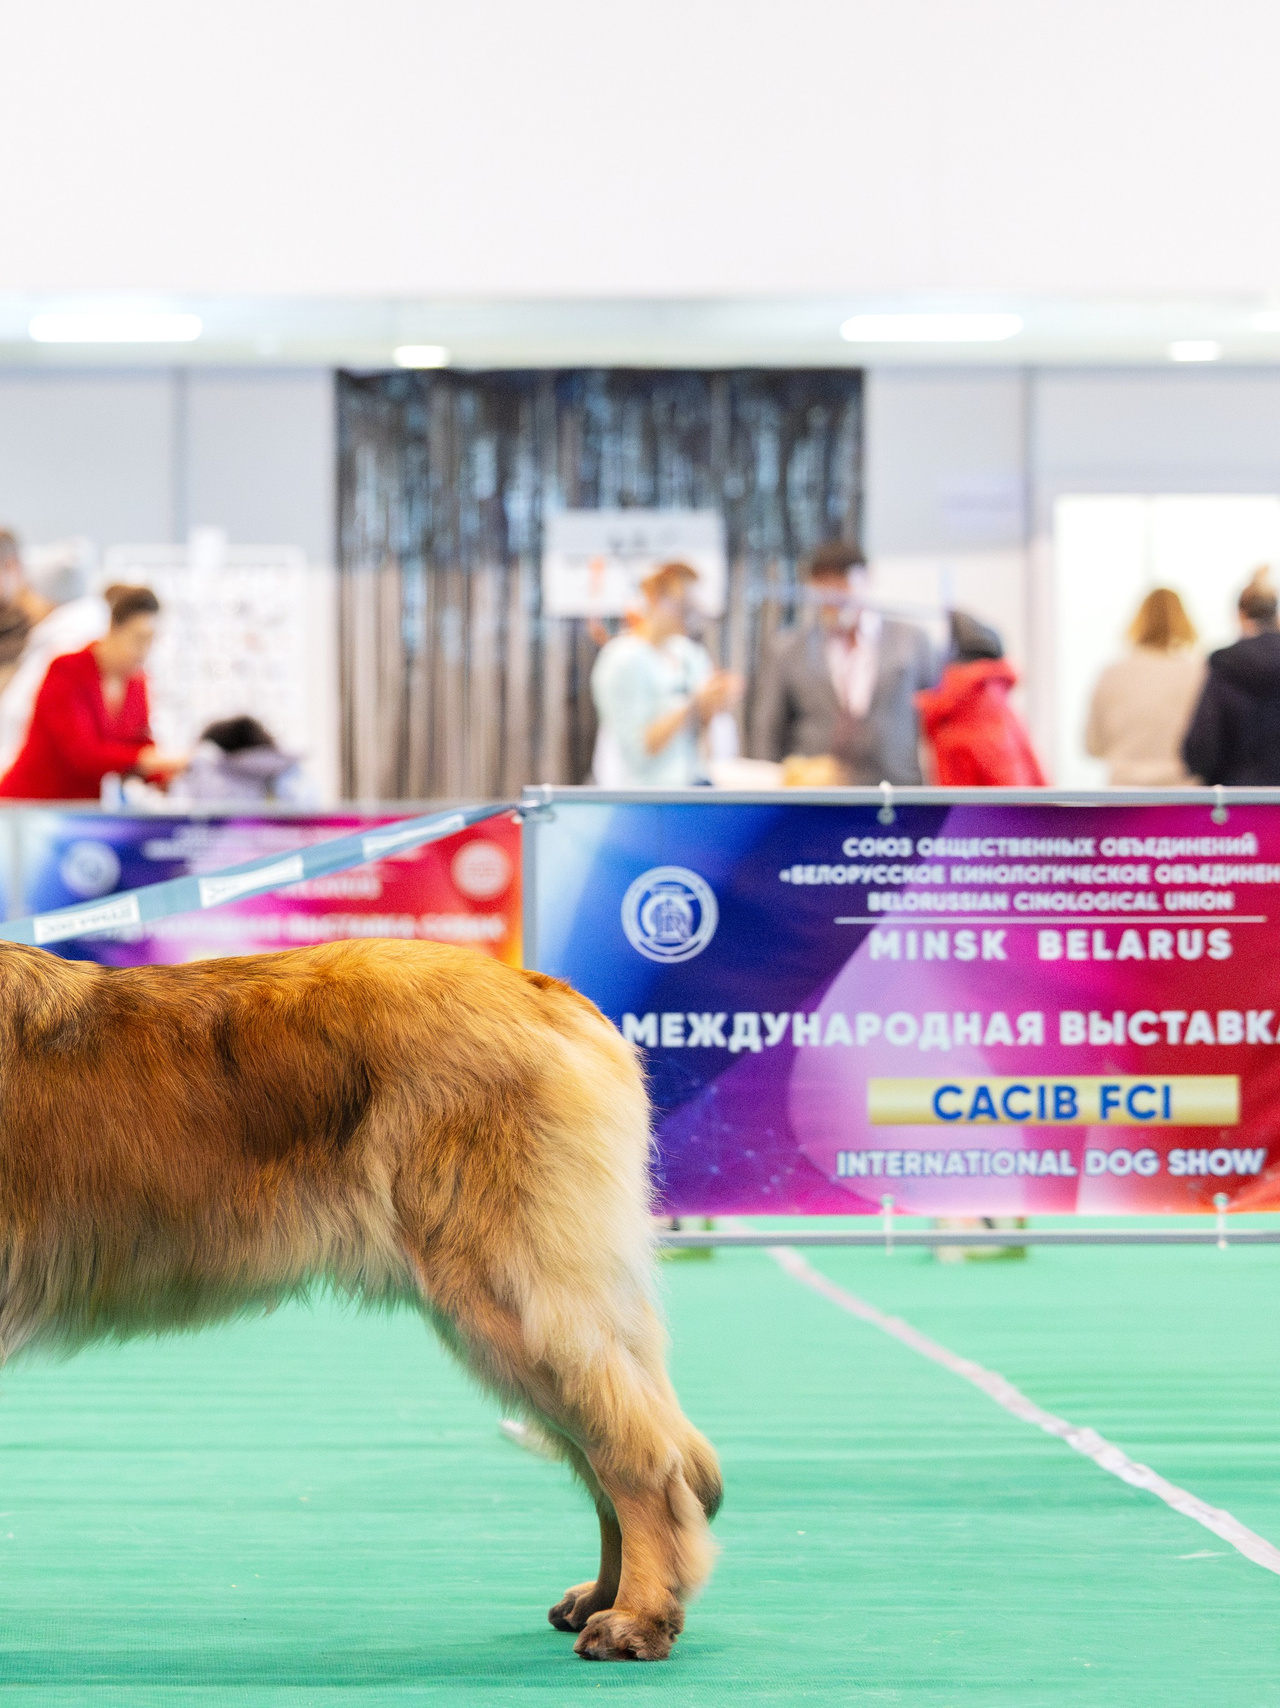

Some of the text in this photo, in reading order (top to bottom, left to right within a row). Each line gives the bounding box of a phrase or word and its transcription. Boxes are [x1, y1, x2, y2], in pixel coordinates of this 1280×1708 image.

[842, 833, 1257, 859] СОЮЗ ОБЩЕСТВЕННЫХ ОБЪЕДИНЕНИЙ
[950, 864, 1149, 885] КИНОЛОГИЧЕСКОЕ
[867, 891, 1234, 912] BELORUSSIAN CINOLOGICAL UNION
[869, 929, 1232, 961] MINSK BELARUS
[621, 1010, 1280, 1054] МЕЖДУНАРОДНАЯ ВЫСТАВК
[932, 1084, 1172, 1122] CACIB FCI
[836, 1147, 1266, 1177] INTERNATIONAL DOG SHOW
